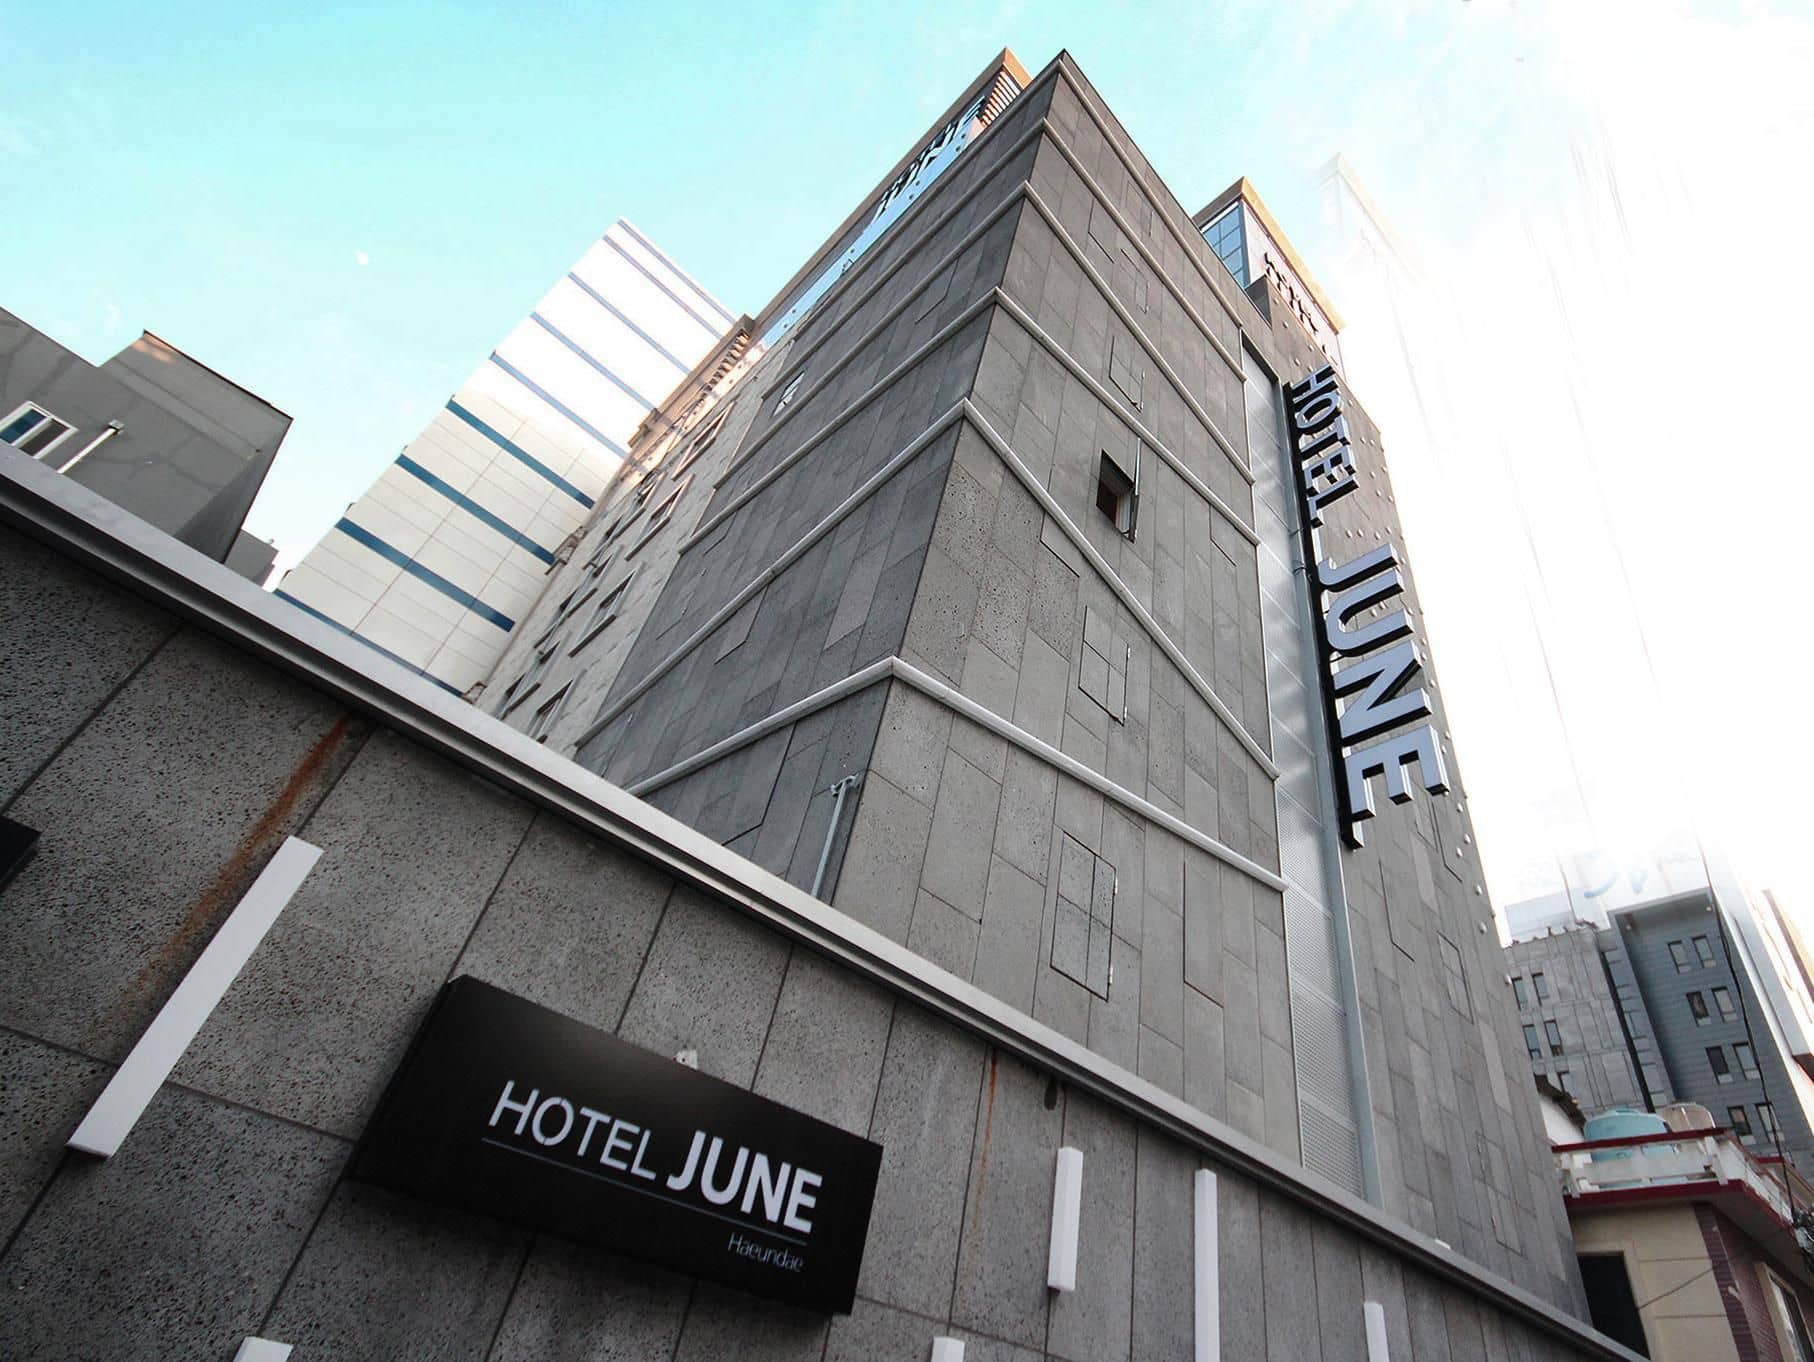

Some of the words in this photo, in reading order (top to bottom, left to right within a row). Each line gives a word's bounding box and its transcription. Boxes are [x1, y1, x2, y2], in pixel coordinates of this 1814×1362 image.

[1291, 365, 1360, 529] HOTEL
[1317, 542, 1450, 820] JUNE
[488, 1079, 656, 1181] HOTEL
[666, 1130, 823, 1234] JUNE
[727, 1231, 805, 1273] Haeundae
